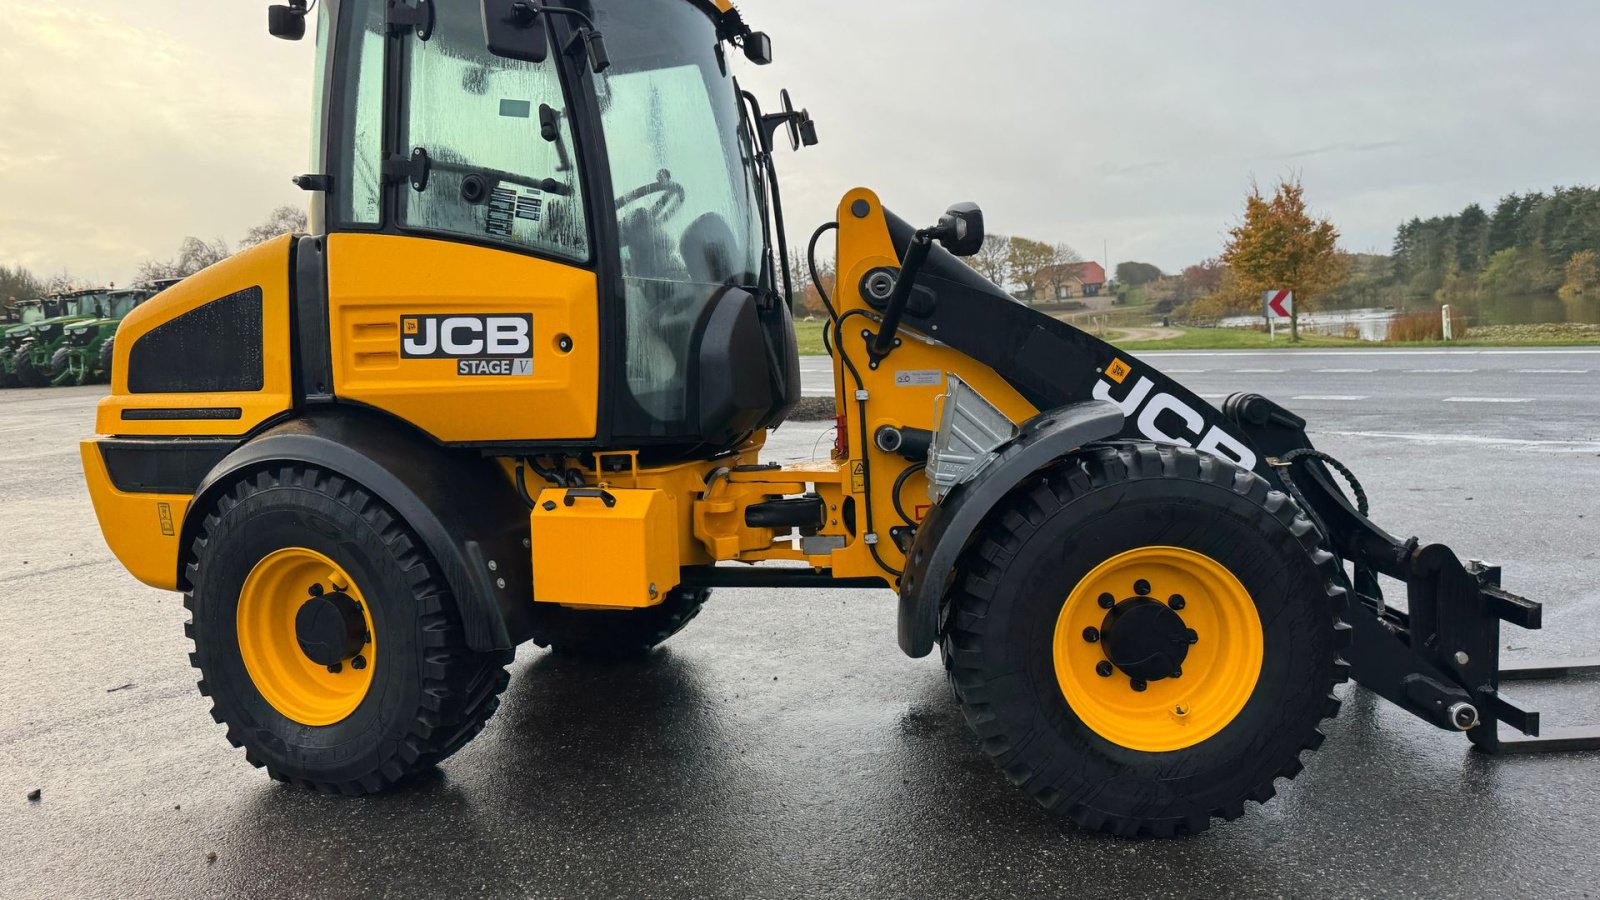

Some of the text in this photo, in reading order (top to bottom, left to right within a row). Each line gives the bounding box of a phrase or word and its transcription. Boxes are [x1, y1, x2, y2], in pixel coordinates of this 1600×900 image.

[404, 317, 530, 355] JCB
[459, 360, 529, 374] STAGE V
